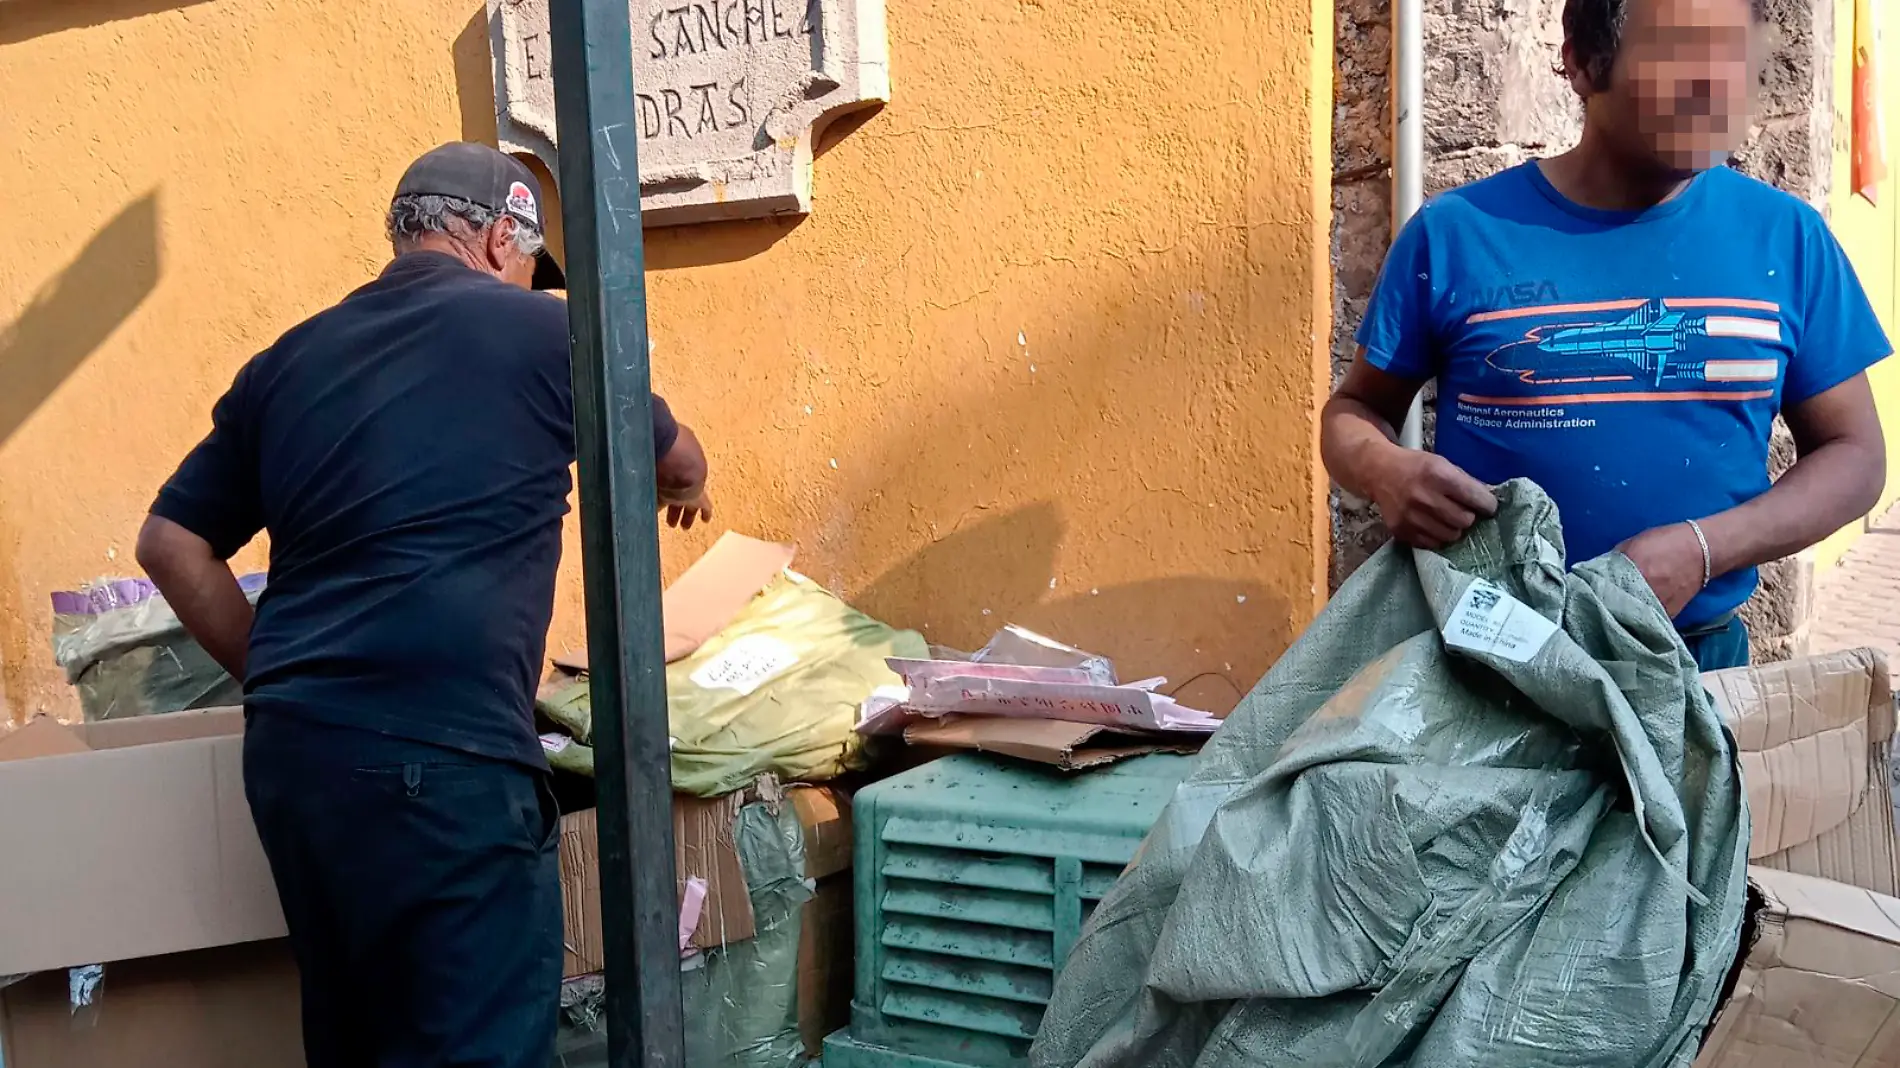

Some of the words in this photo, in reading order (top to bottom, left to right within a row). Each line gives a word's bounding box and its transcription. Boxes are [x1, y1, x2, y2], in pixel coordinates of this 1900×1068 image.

[523, 31, 551, 79] E
[1471, 280, 1559, 311] NASA
[1457, 402, 1491, 415] National
[1494, 406, 1564, 417] Aeronautics
[1456, 413, 1472, 424] and
[1474, 415, 1502, 428] Space
[1505, 418, 1596, 429] Administration
[1461, 627, 1482, 639] Made
[1483, 634, 1491, 642] in
